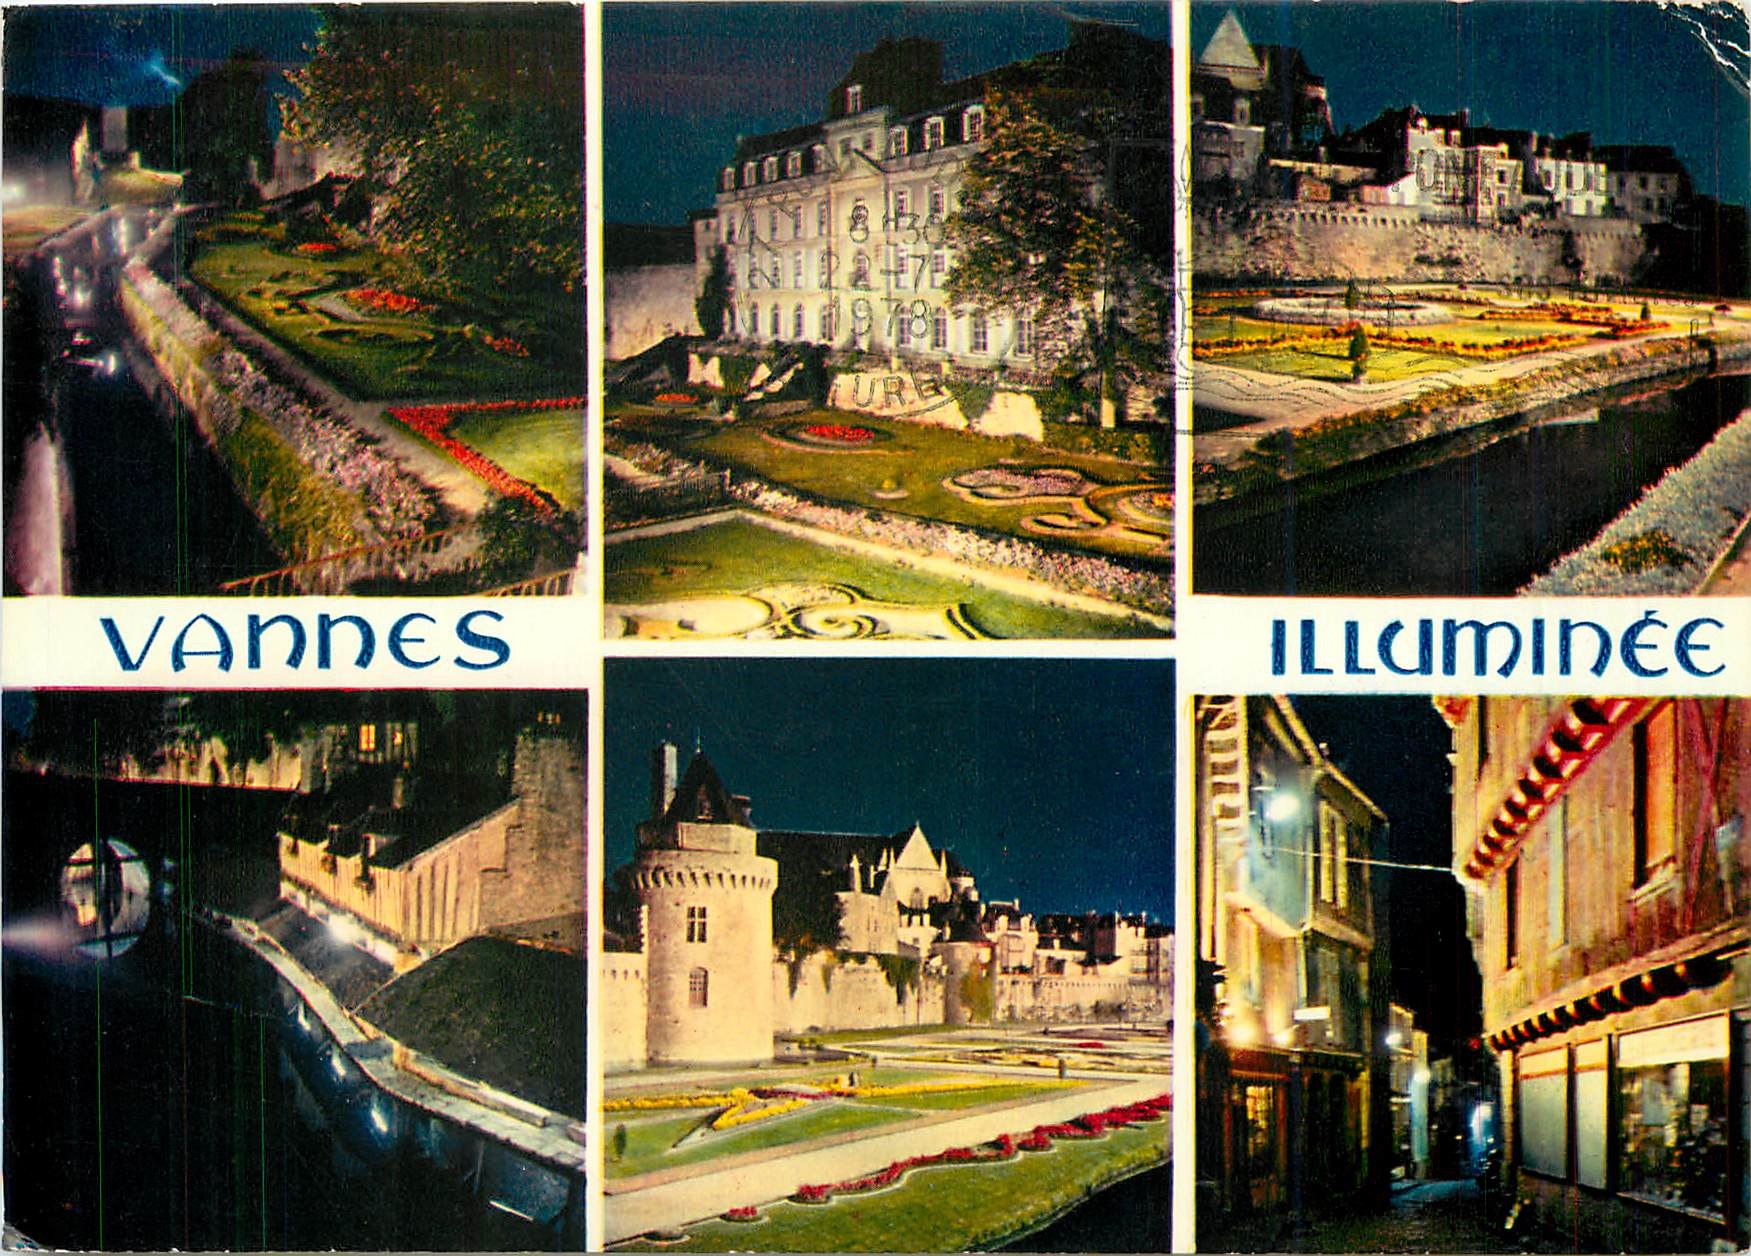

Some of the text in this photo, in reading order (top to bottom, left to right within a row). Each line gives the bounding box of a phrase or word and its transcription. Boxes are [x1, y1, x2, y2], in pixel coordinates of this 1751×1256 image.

[829, 297, 931, 339] 1978
[99, 609, 512, 673] VANNES
[1270, 610, 1727, 678] ILLUMINÉE
